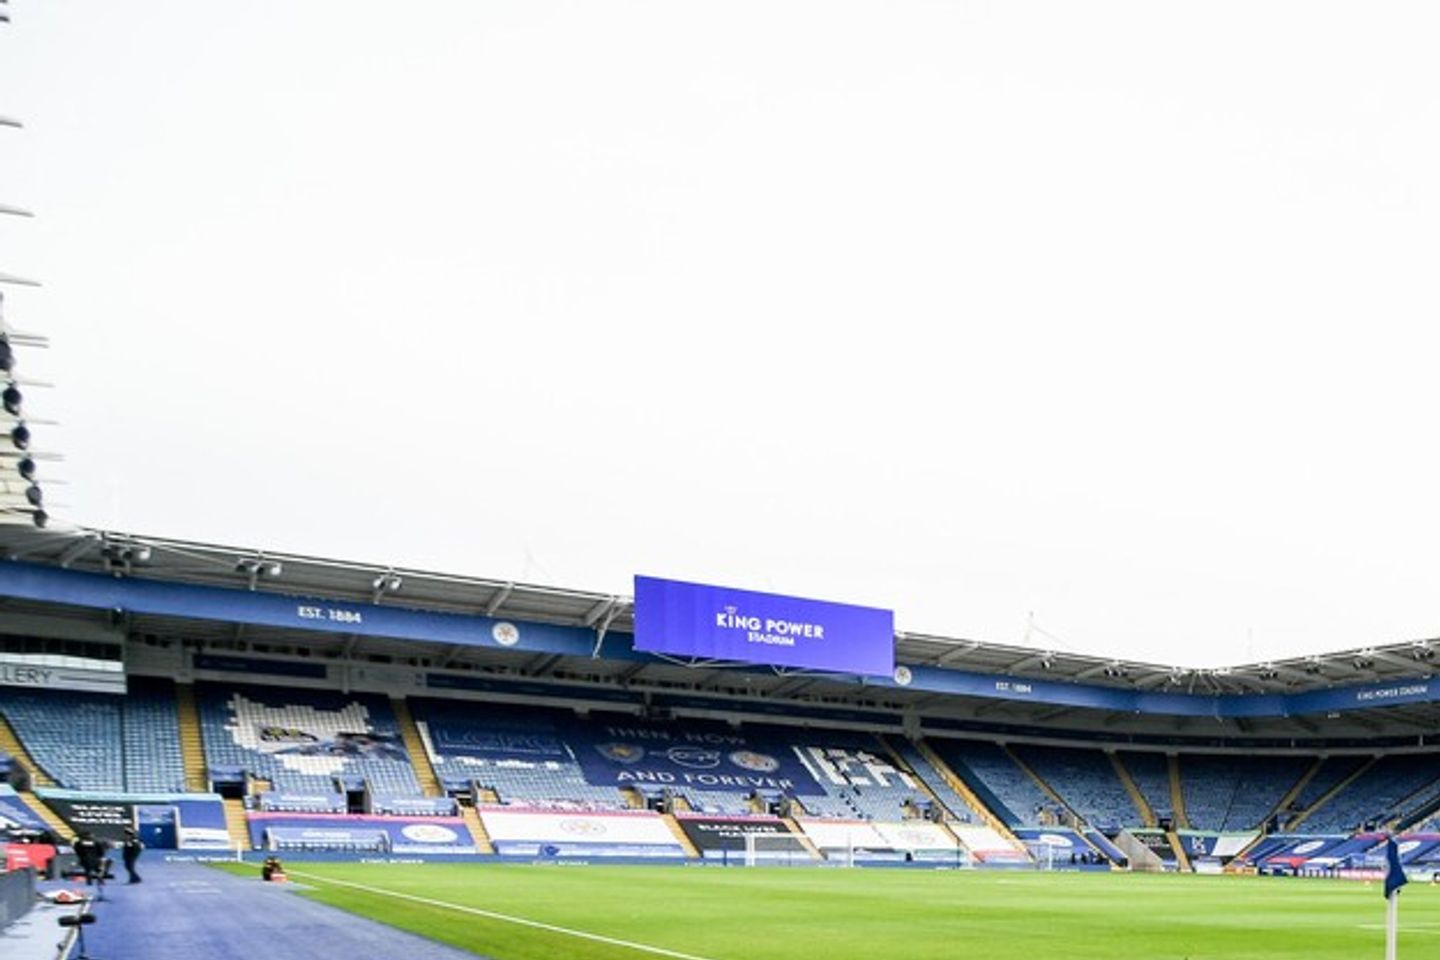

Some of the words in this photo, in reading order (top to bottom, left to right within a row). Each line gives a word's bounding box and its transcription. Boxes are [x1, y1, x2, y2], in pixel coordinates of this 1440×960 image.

[716, 612, 761, 631] KING
[766, 619, 824, 639] POWER
[748, 632, 795, 646] STADIUM
[617, 771, 675, 783] AND
[684, 773, 795, 790] FOREVER
